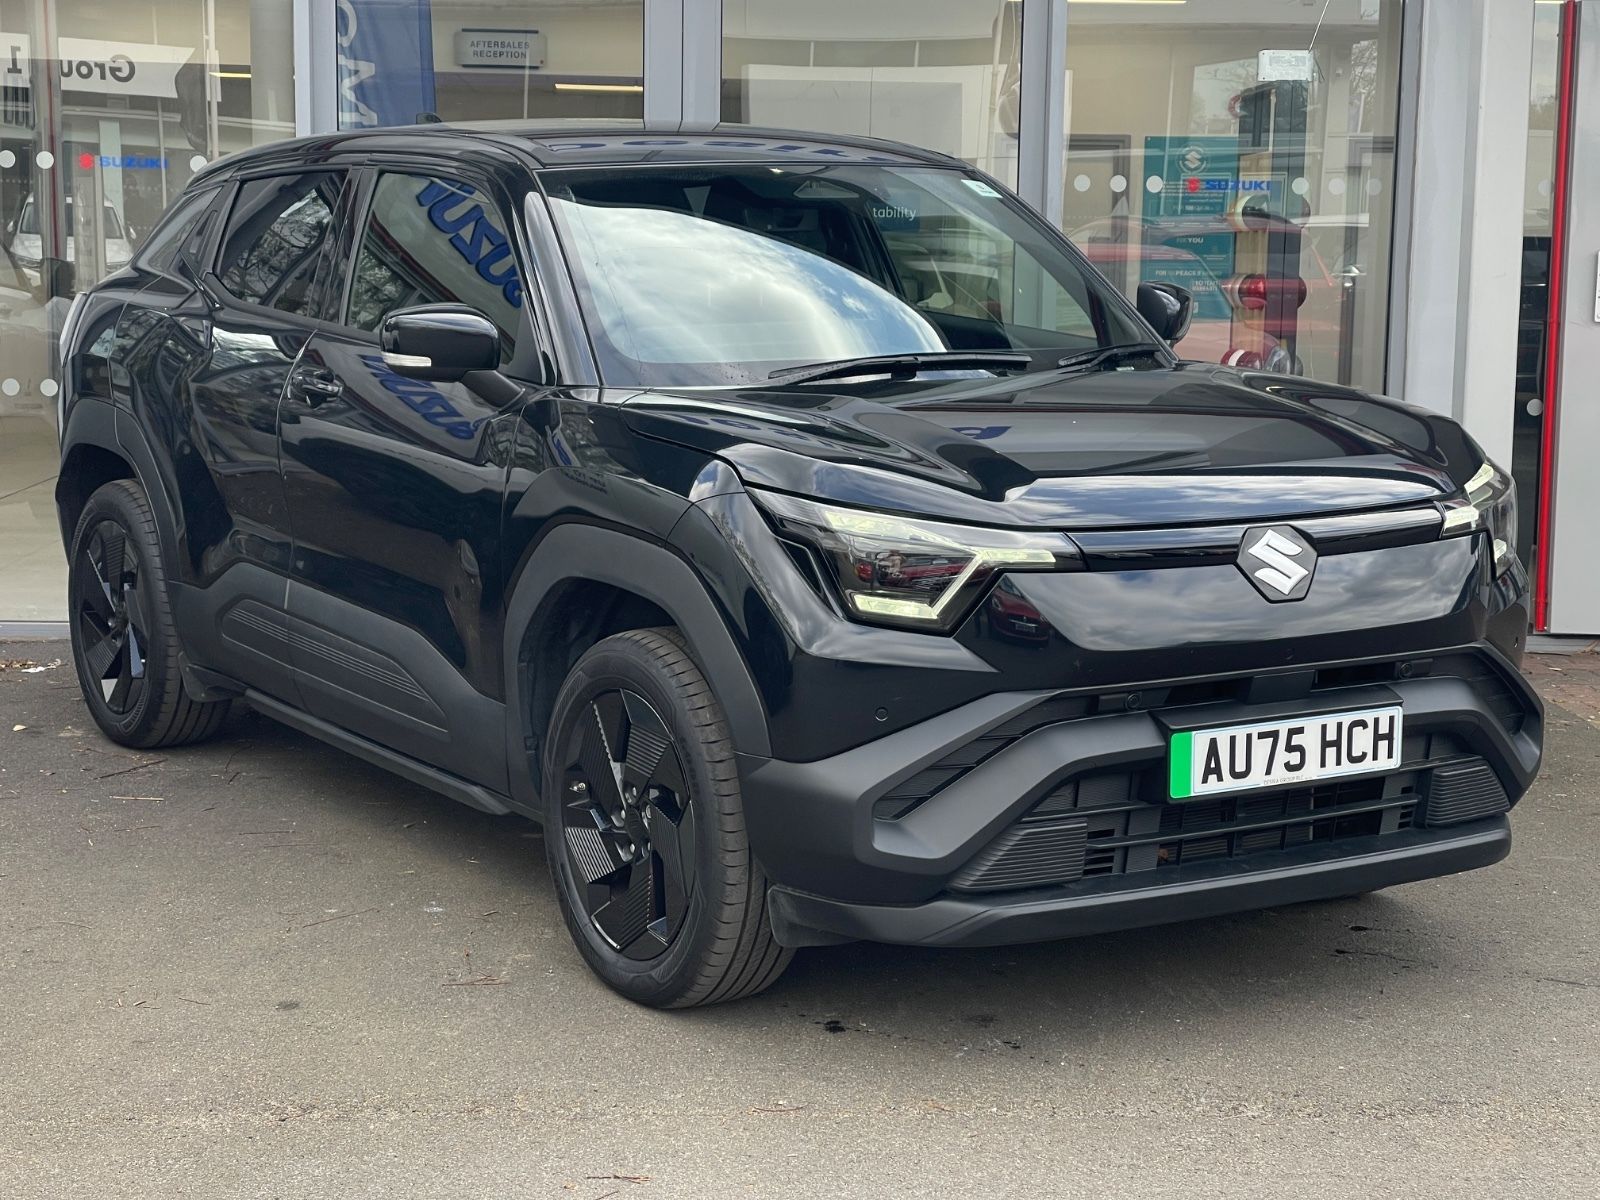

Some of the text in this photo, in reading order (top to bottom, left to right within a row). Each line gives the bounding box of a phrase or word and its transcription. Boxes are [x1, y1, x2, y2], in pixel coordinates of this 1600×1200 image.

[470, 40, 530, 50] AFTERSALES
[473, 50, 527, 59] RECEPTION
[99, 155, 169, 170] SUZUKI
[1204, 180, 1272, 192] SUZUKI
[873, 206, 917, 221] tability
[1201, 715, 1395, 785] AU75 HCH
